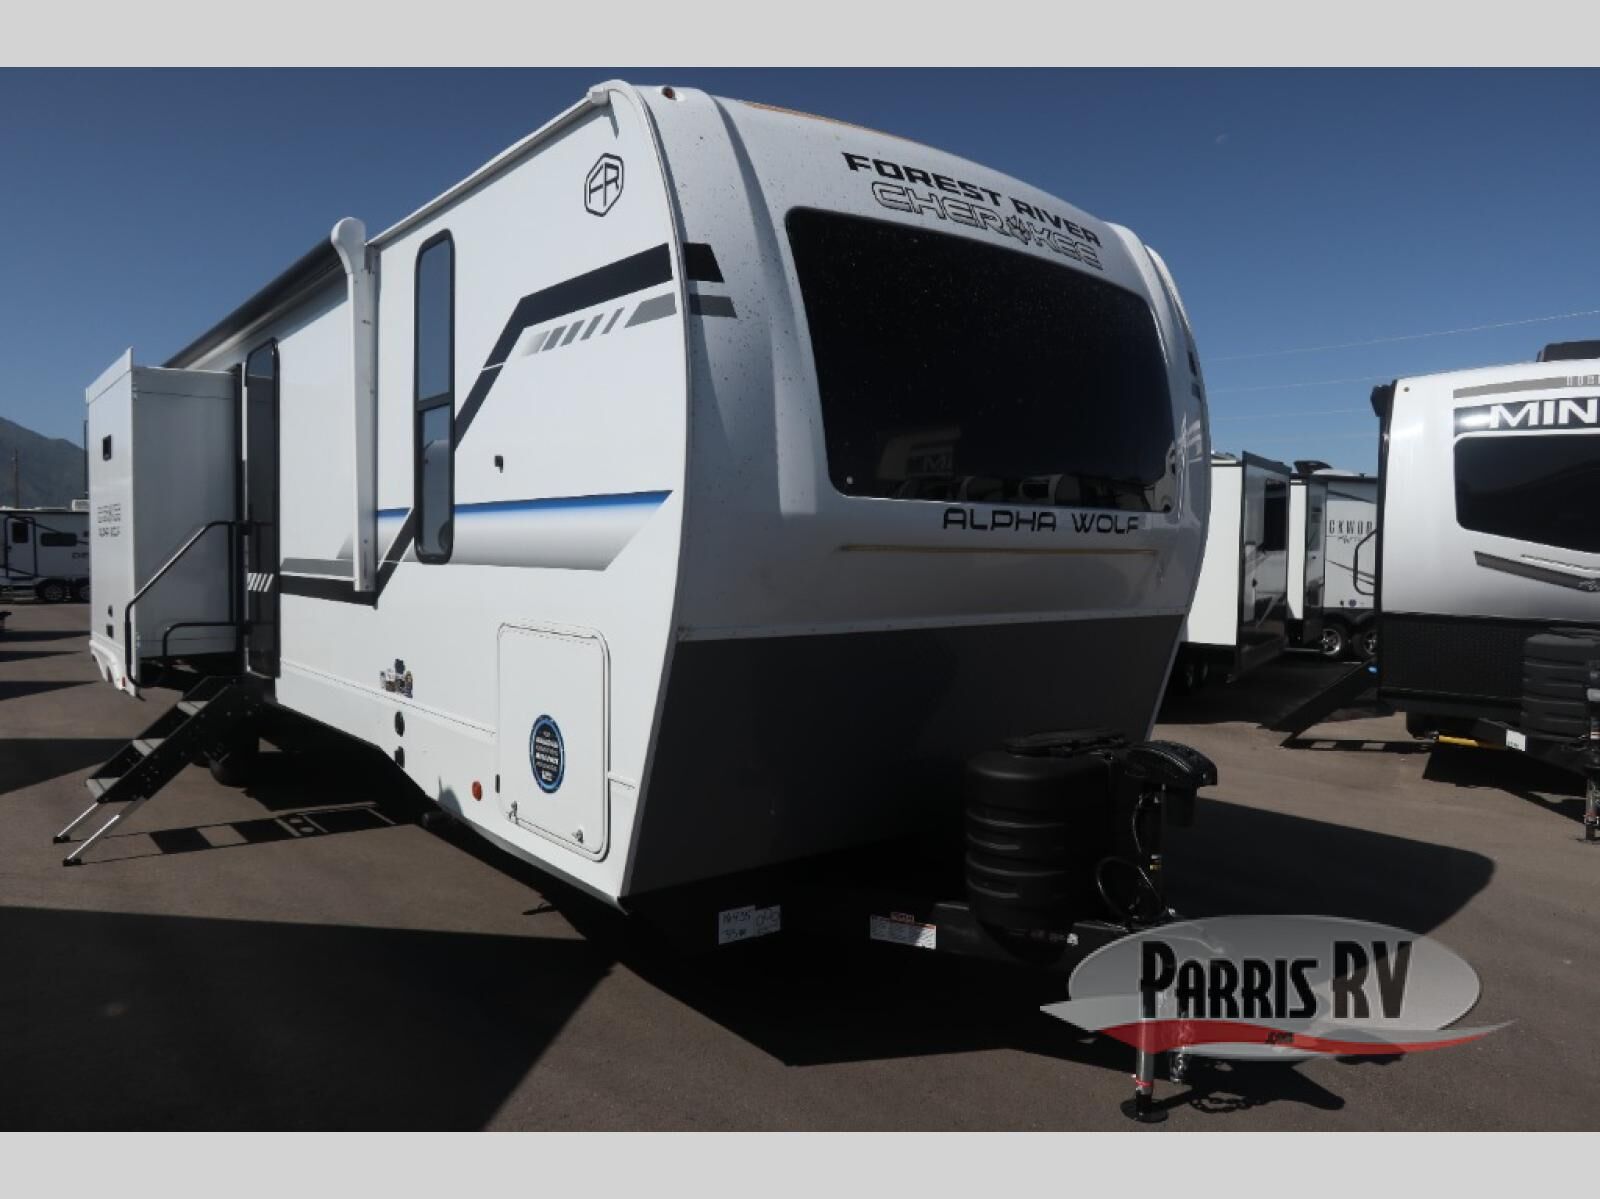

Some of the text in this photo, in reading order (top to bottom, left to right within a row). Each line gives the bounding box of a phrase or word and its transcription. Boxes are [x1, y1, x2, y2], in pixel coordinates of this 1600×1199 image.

[841, 151, 1104, 249] FOREST RIVER
[1489, 399, 1598, 429] MIN
[943, 507, 1140, 535] ALPHA WOLF
